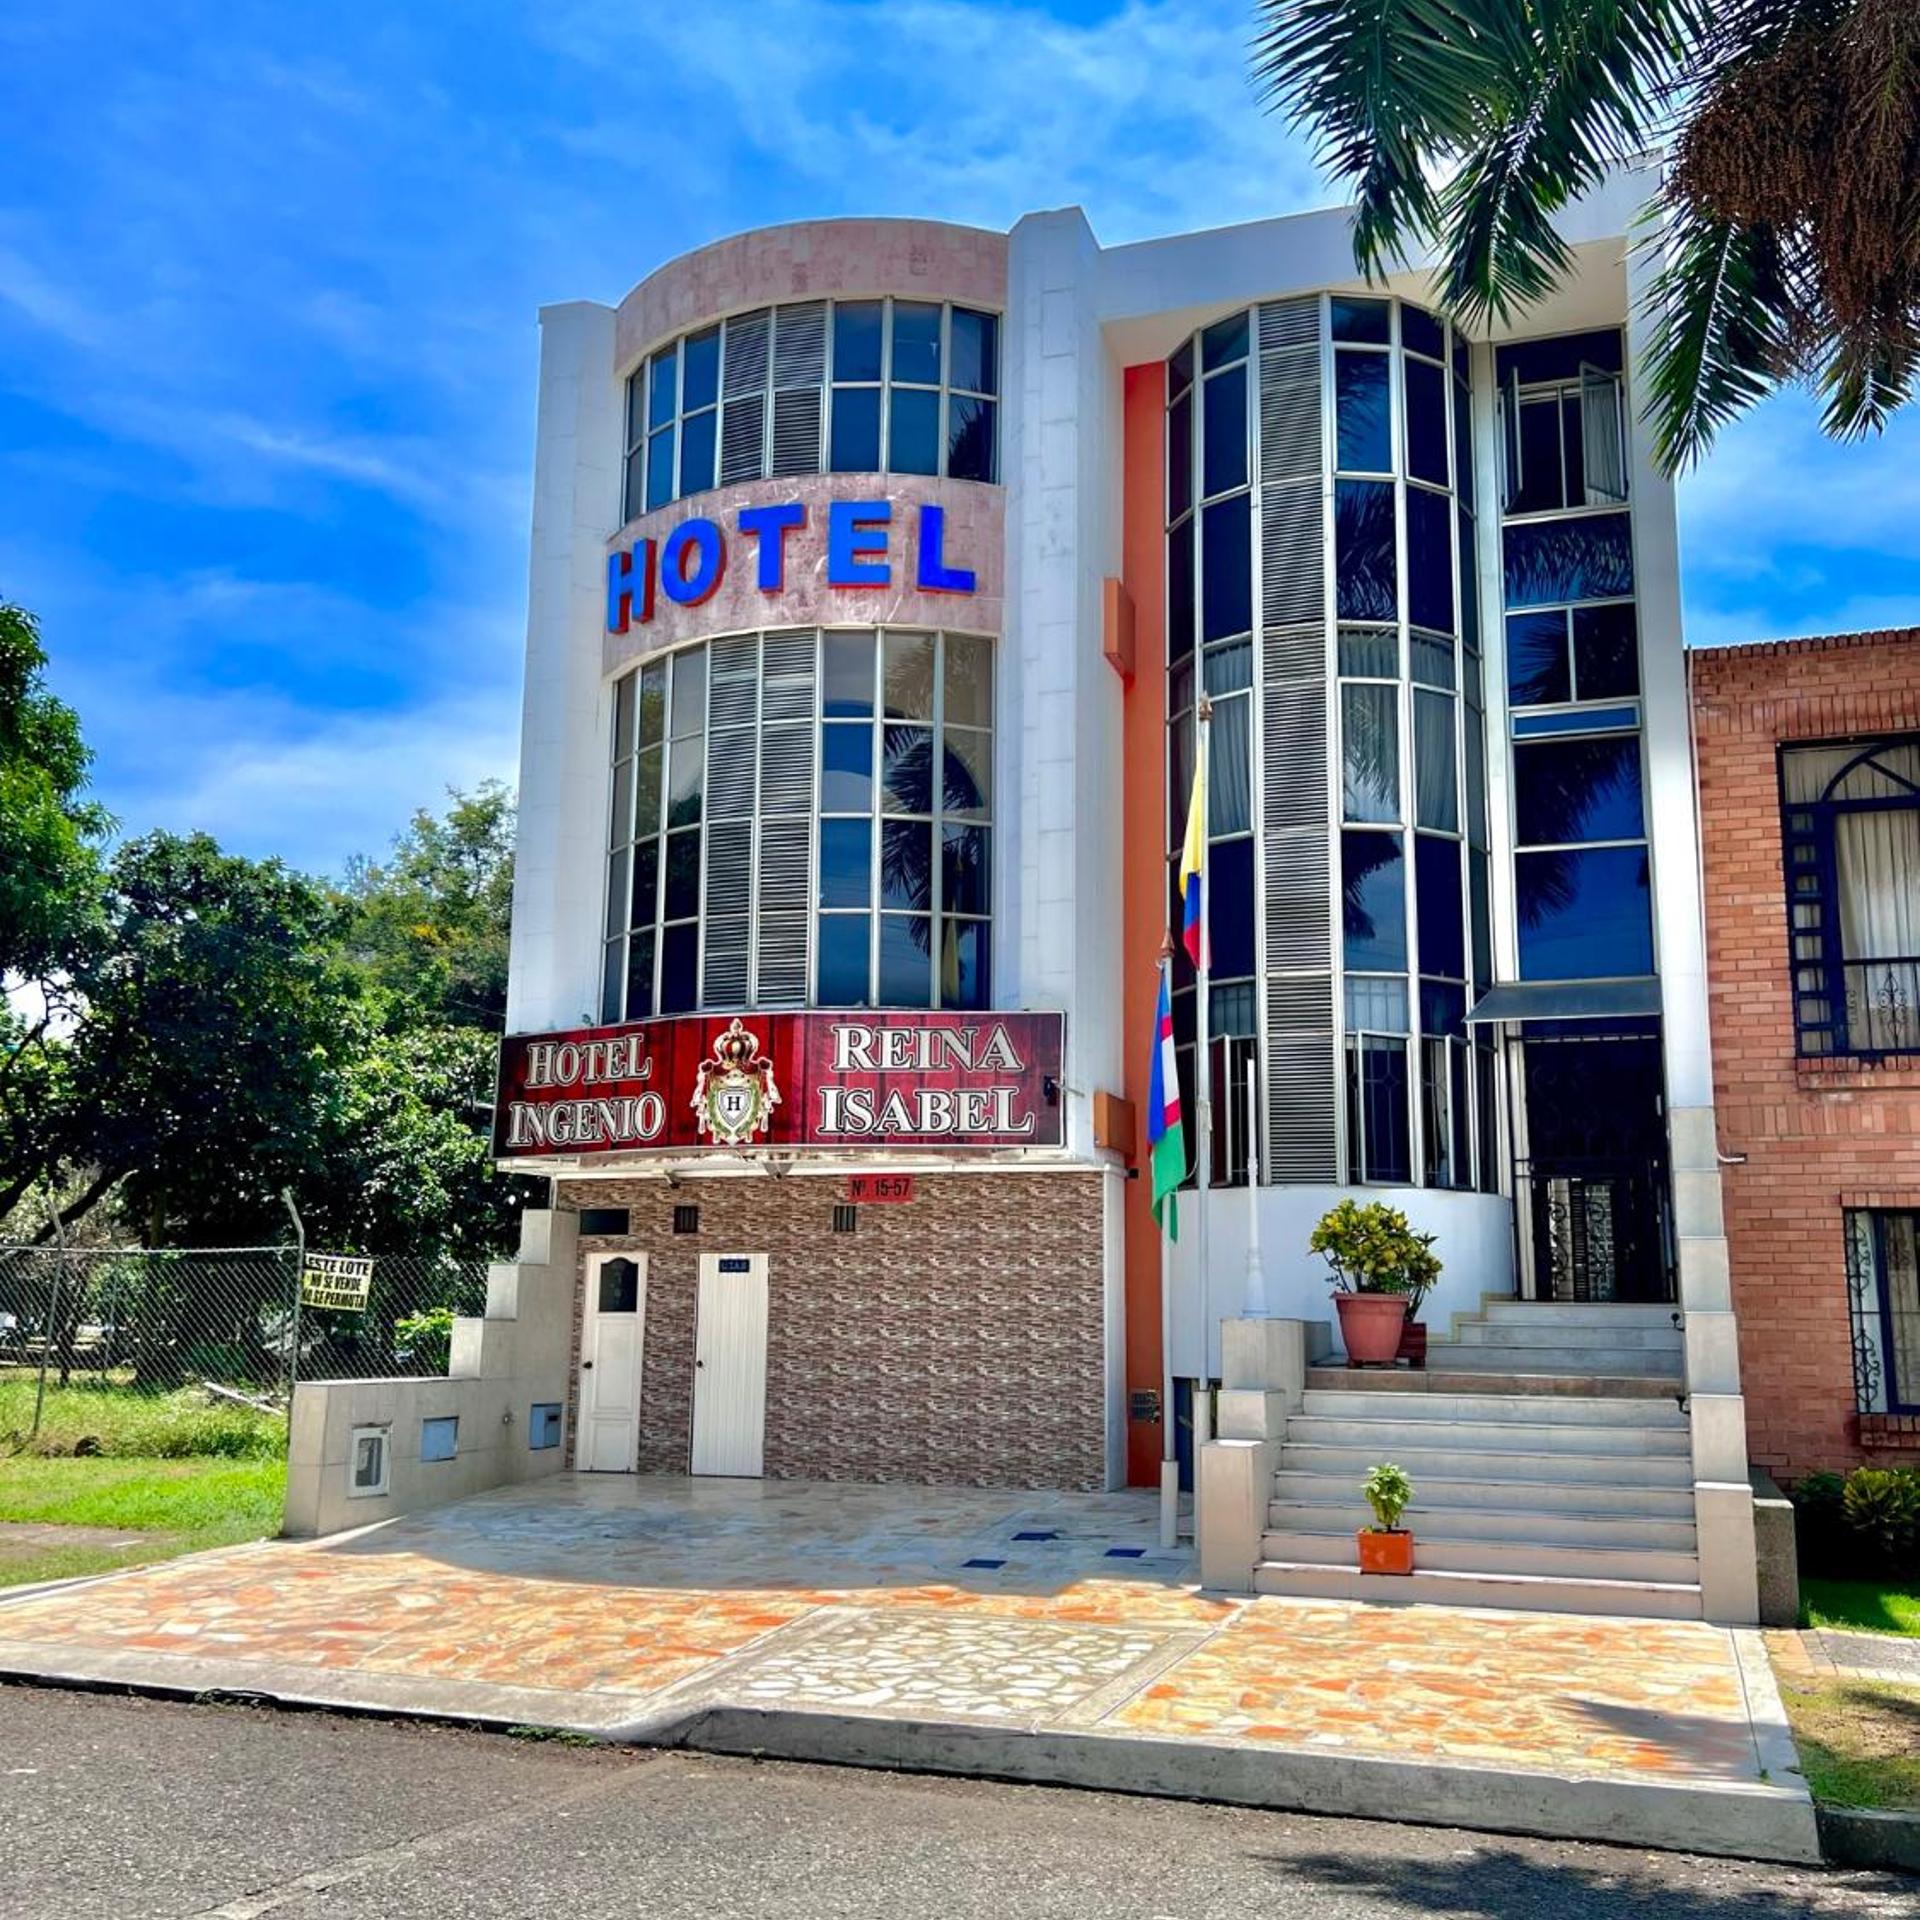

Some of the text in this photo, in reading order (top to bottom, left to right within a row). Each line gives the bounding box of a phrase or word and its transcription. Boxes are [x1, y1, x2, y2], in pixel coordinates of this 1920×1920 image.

[607, 501, 976, 635] HOTEL
[525, 1034, 652, 1088] HOTEL
[831, 1024, 1025, 1073] REINA
[507, 1092, 665, 1147] INGENIO
[727, 1096, 741, 1111] H
[817, 1087, 1035, 1136] ISABEL
[874, 1178, 910, 1196] 15-57
[308, 1256, 370, 1276] ESTE LOTE
[310, 1273, 362, 1291] NO SE VENDE
[313, 1289, 324, 1304] SE
